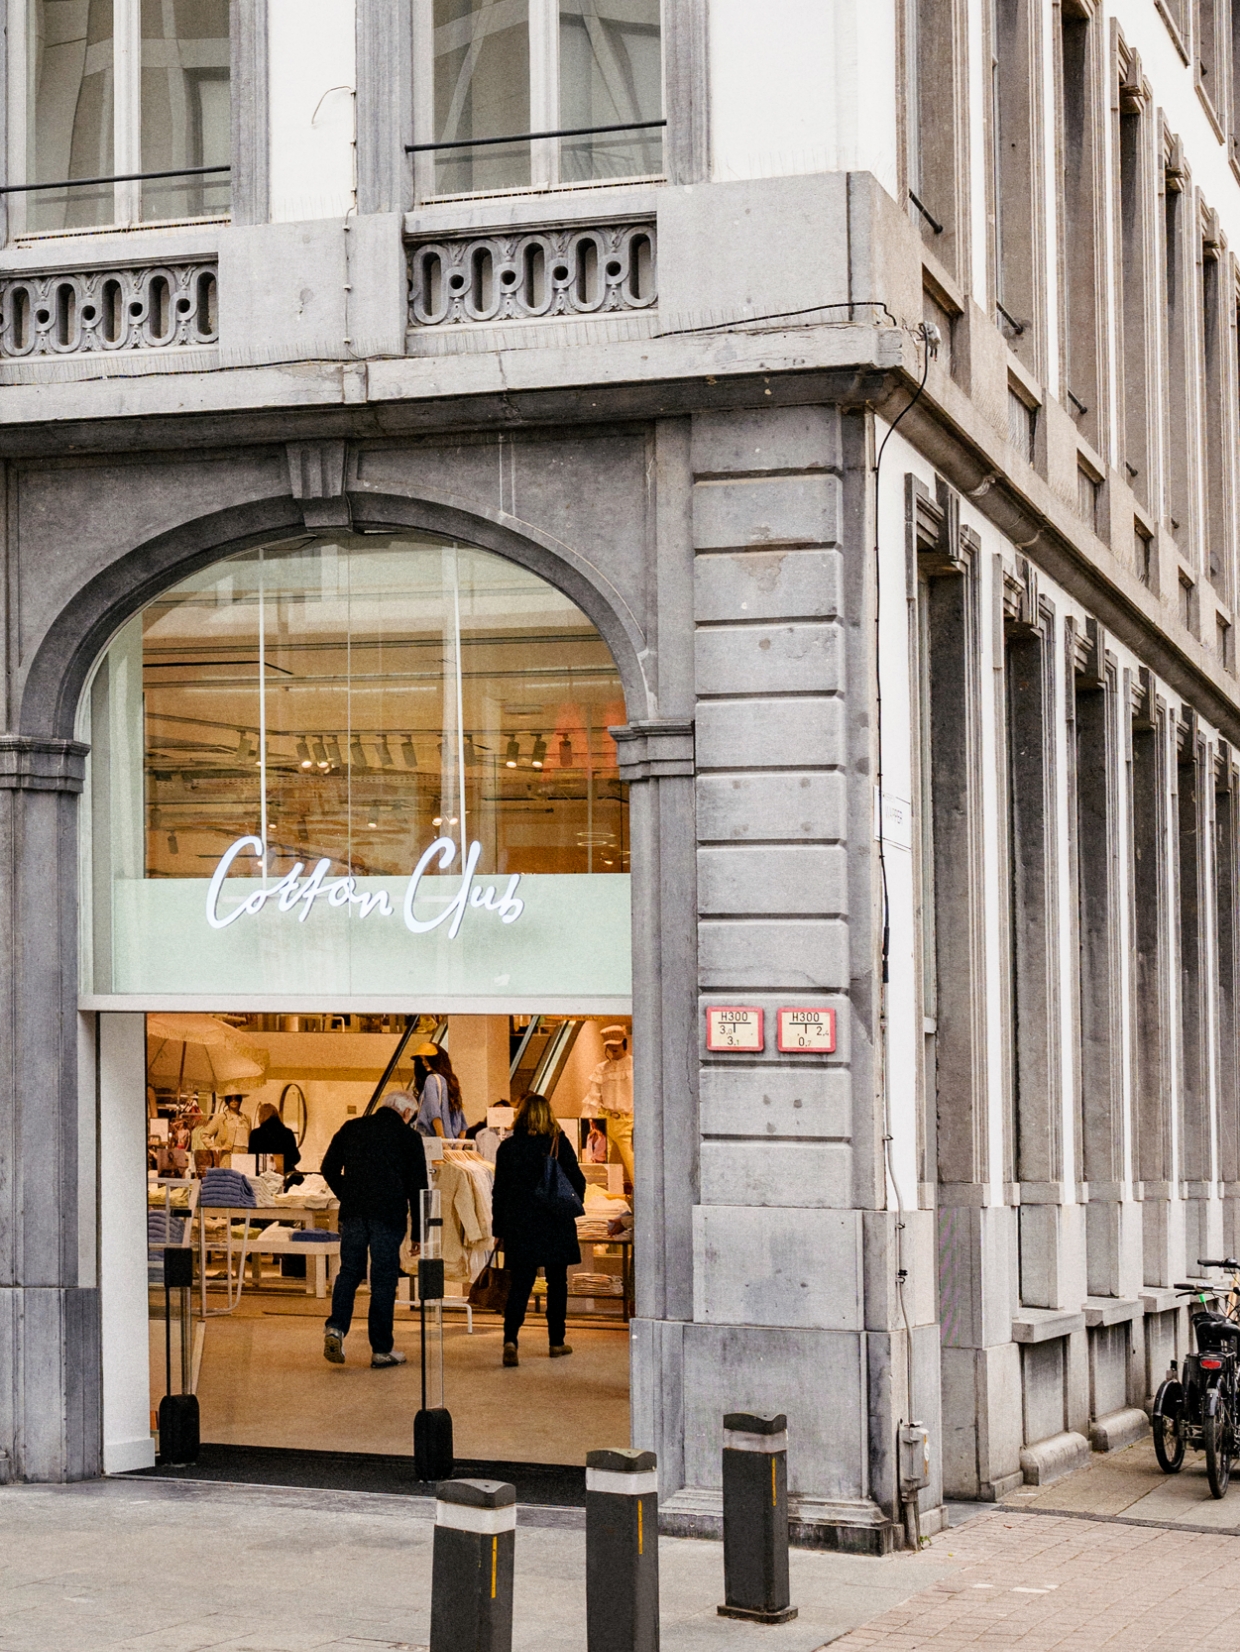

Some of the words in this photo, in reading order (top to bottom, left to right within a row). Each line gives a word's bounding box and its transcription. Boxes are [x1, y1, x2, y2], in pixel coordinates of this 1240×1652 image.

[206, 835, 394, 929] Cotton
[403, 836, 525, 939] Club
[721, 1011, 748, 1022] H300
[792, 1011, 820, 1022] H300
